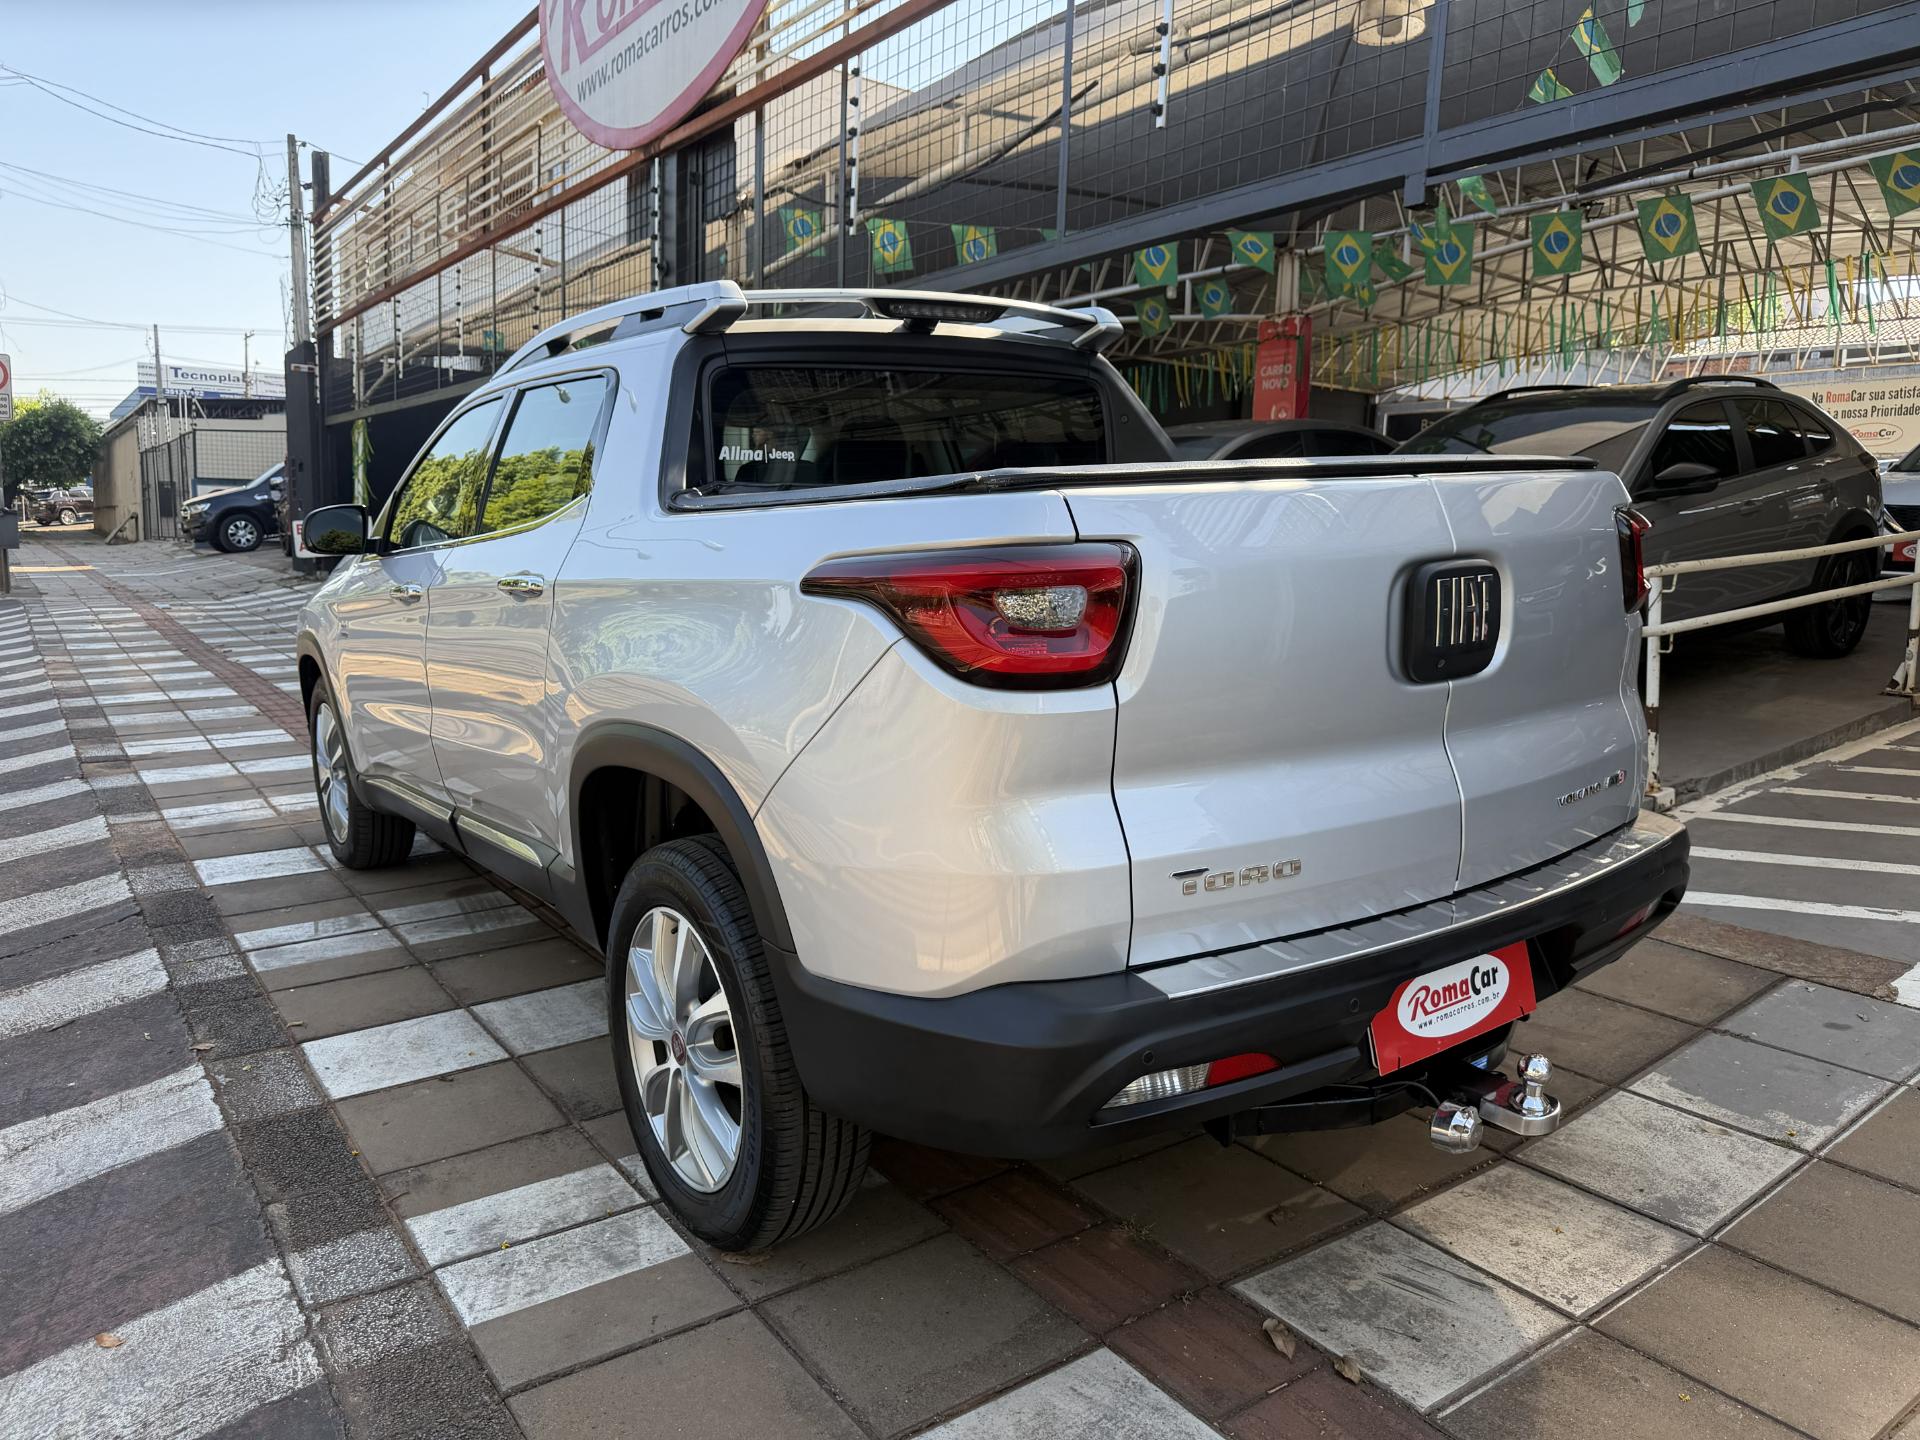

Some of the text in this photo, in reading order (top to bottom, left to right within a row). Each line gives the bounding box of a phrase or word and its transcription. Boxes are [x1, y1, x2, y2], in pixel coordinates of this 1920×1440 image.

[577, 0, 722, 103] www.romacarros.co
[1826, 389, 1866, 403] RomaCar
[1868, 390, 1885, 401] sua
[1841, 408, 1868, 419] nossa
[1870, 402, 1920, 418] Prioridade
[769, 448, 795, 461] Jeep
[1435, 573, 1494, 648] FIAT
[1556, 782, 1601, 807] VOLCANO
[1169, 858, 1302, 896] TORO
[1408, 965, 1499, 1022] RomaCar
[1418, 991, 1500, 1030] www.romacarros.com.br
